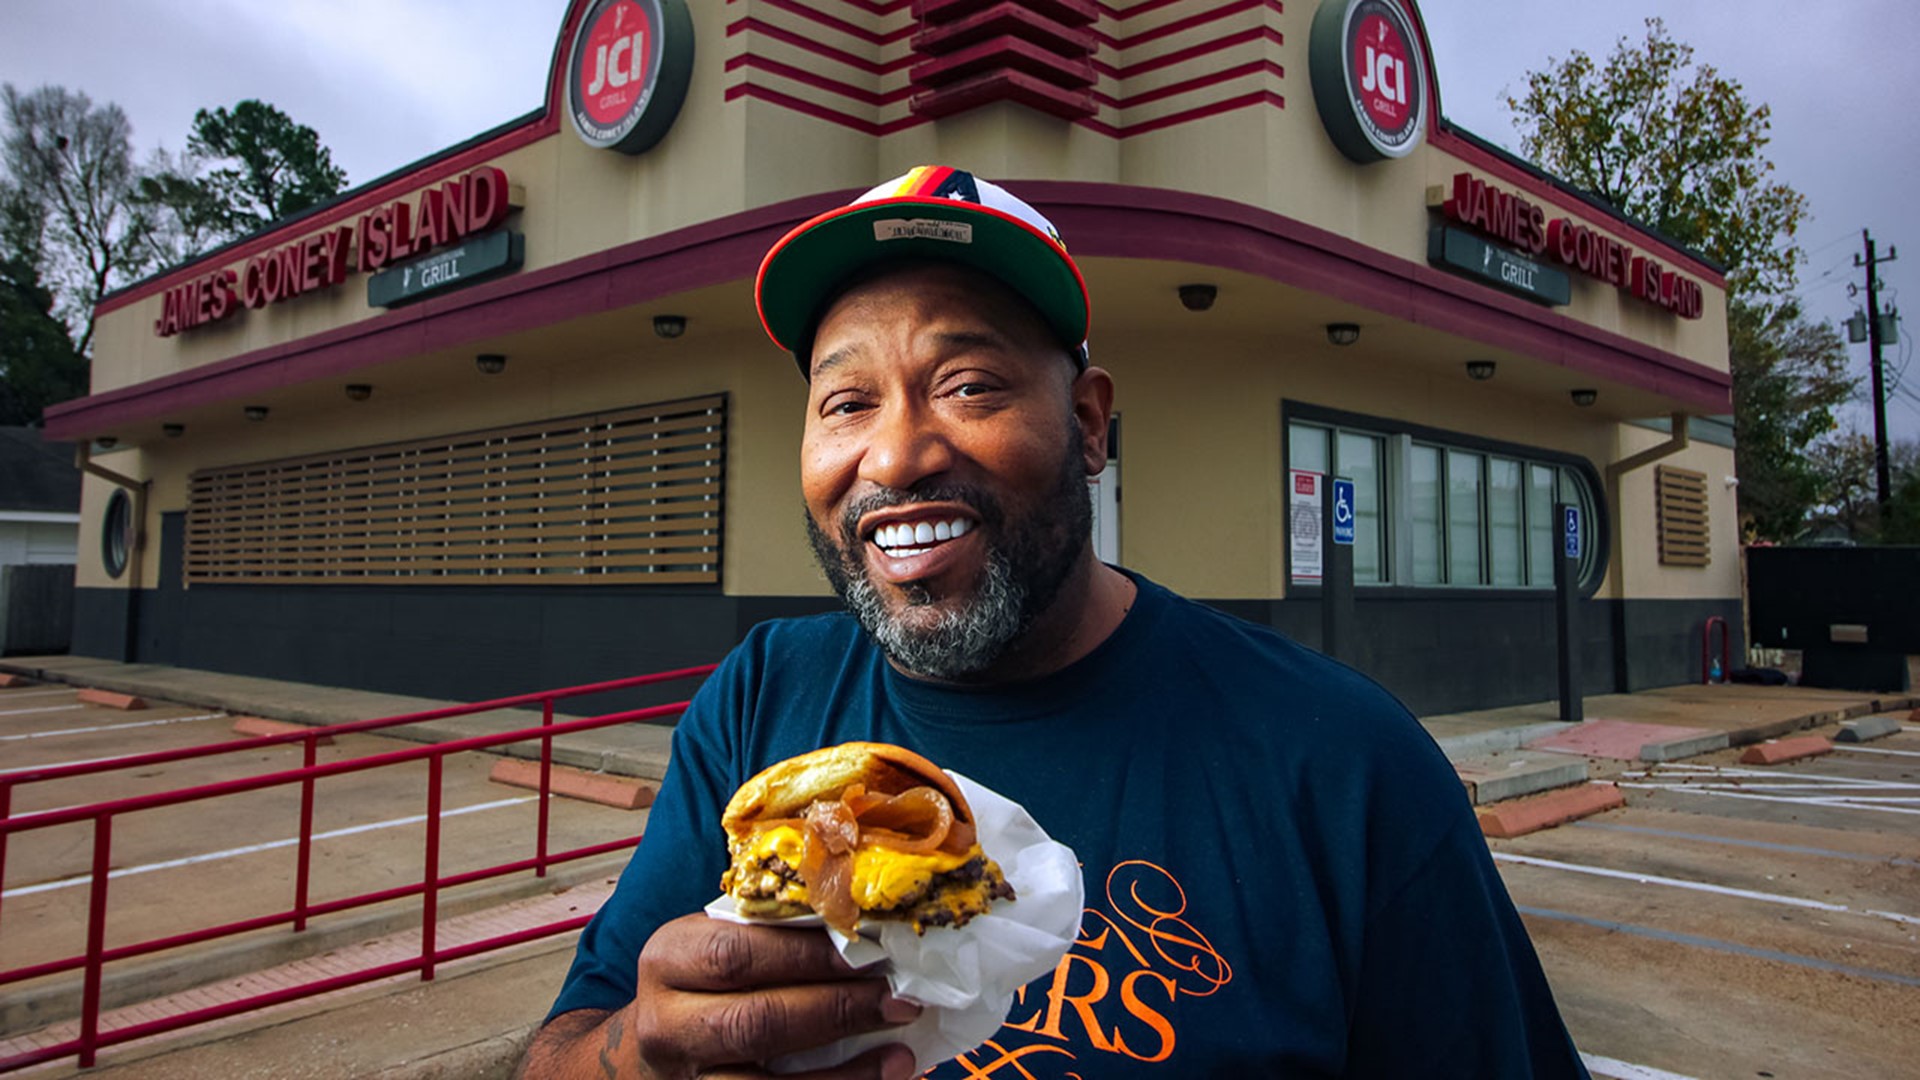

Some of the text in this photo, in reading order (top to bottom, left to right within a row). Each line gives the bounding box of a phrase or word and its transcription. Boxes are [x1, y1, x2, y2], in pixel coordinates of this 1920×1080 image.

[588, 31, 643, 96] JCI
[1362, 45, 1406, 105] JCI
[156, 166, 509, 337] JAMES CONEY ISLAND
[420, 260, 460, 288] GRILL
[1452, 173, 1703, 320] JAMES CONEY ISLAND
[1501, 260, 1535, 291] GRILL
